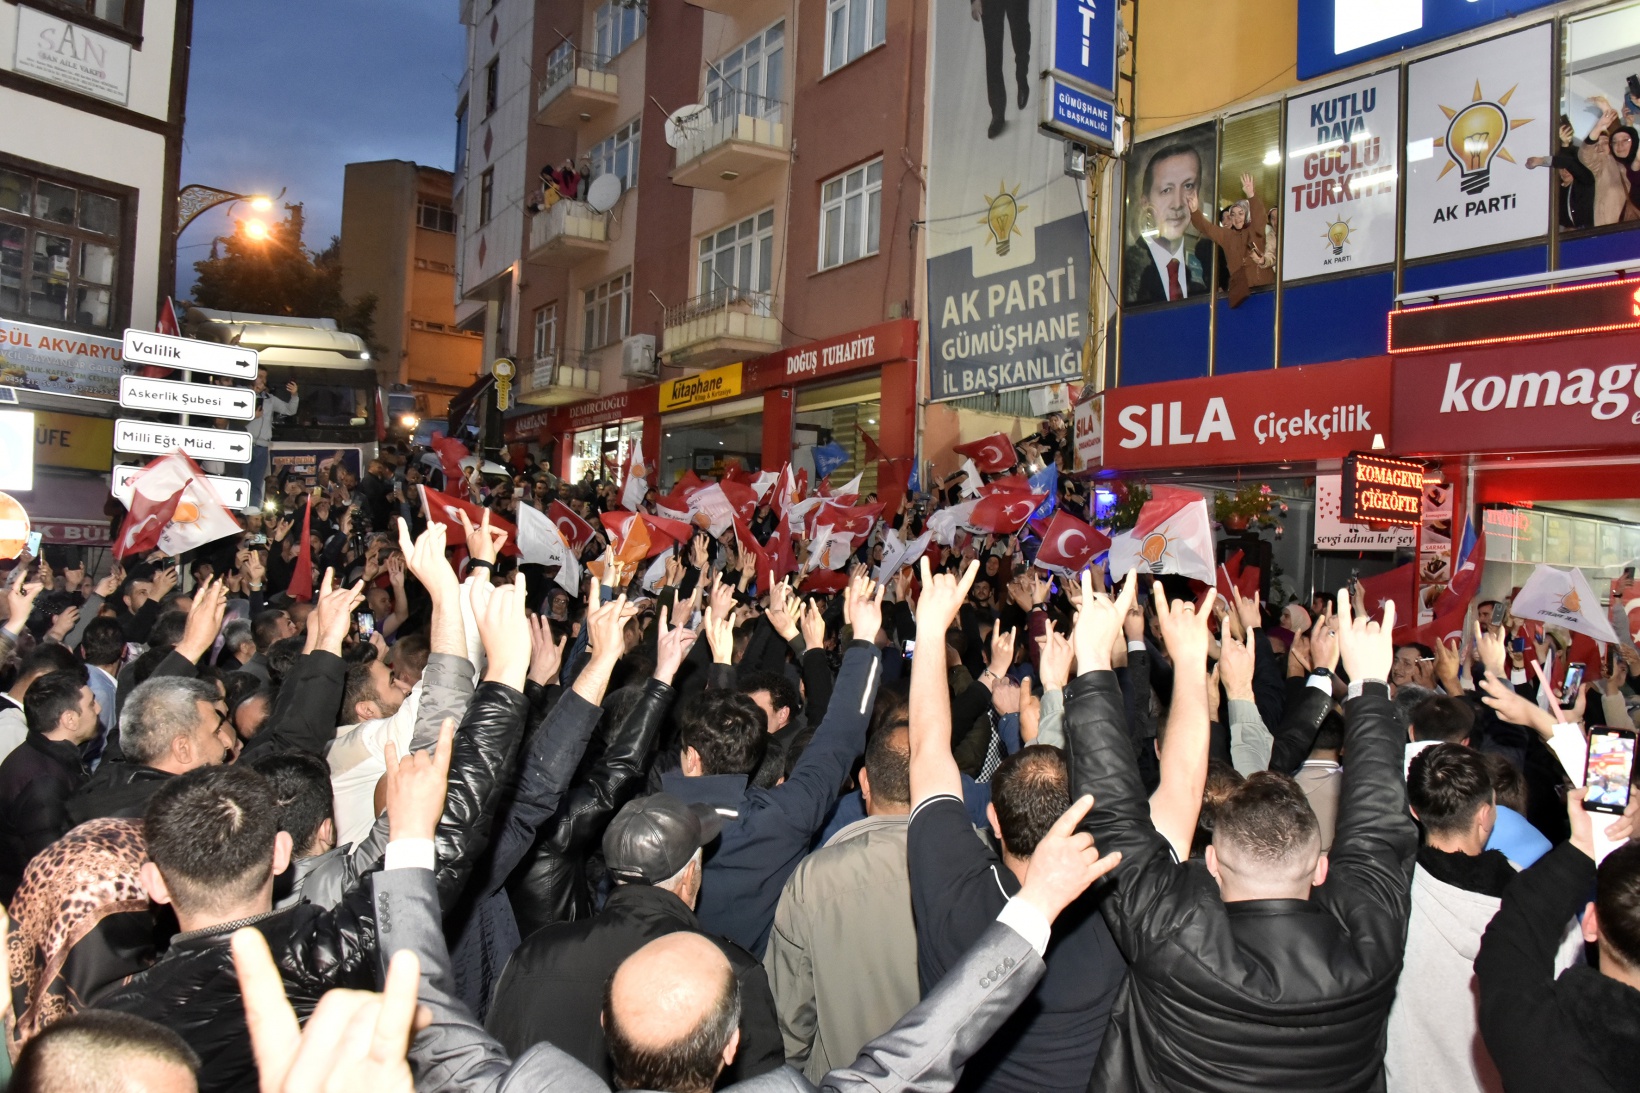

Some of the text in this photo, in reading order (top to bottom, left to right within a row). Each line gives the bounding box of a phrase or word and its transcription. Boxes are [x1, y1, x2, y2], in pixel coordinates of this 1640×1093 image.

[1059, 92, 1108, 120] GÜMÜŞHANE
[1059, 104, 1108, 132] İL BAŞKANLIĞI
[1310, 87, 1376, 128] KUTLU
[1433, 205, 1458, 224] AK
[942, 256, 1076, 328] AK PARTİ
[38, 336, 122, 362] AKVARYU
[942, 312, 1080, 361] GÜMÜŞHANE
[26, 354, 85, 368] HAYVANLAR
[132, 340, 181, 360] Valilik
[786, 334, 875, 375] DOĞUŞ TUHAFİYE
[943, 348, 1082, 394] İL BAŞKANLIĞI
[128, 388, 222, 406] Askerlik Şubesi
[672, 376, 722, 401] kitaphane
[1076, 414, 1094, 439] SILA
[1118, 396, 1372, 449] SILA Çiçekçilik
[36, 424, 71, 448] ÜFE
[123, 432, 215, 450] Milli Eğt. Müd.
[1356, 464, 1422, 489] KOMAGENE
[1361, 488, 1418, 513] ÇİĞKÖFTE
[1317, 532, 1415, 548] sevgi adına her şey
